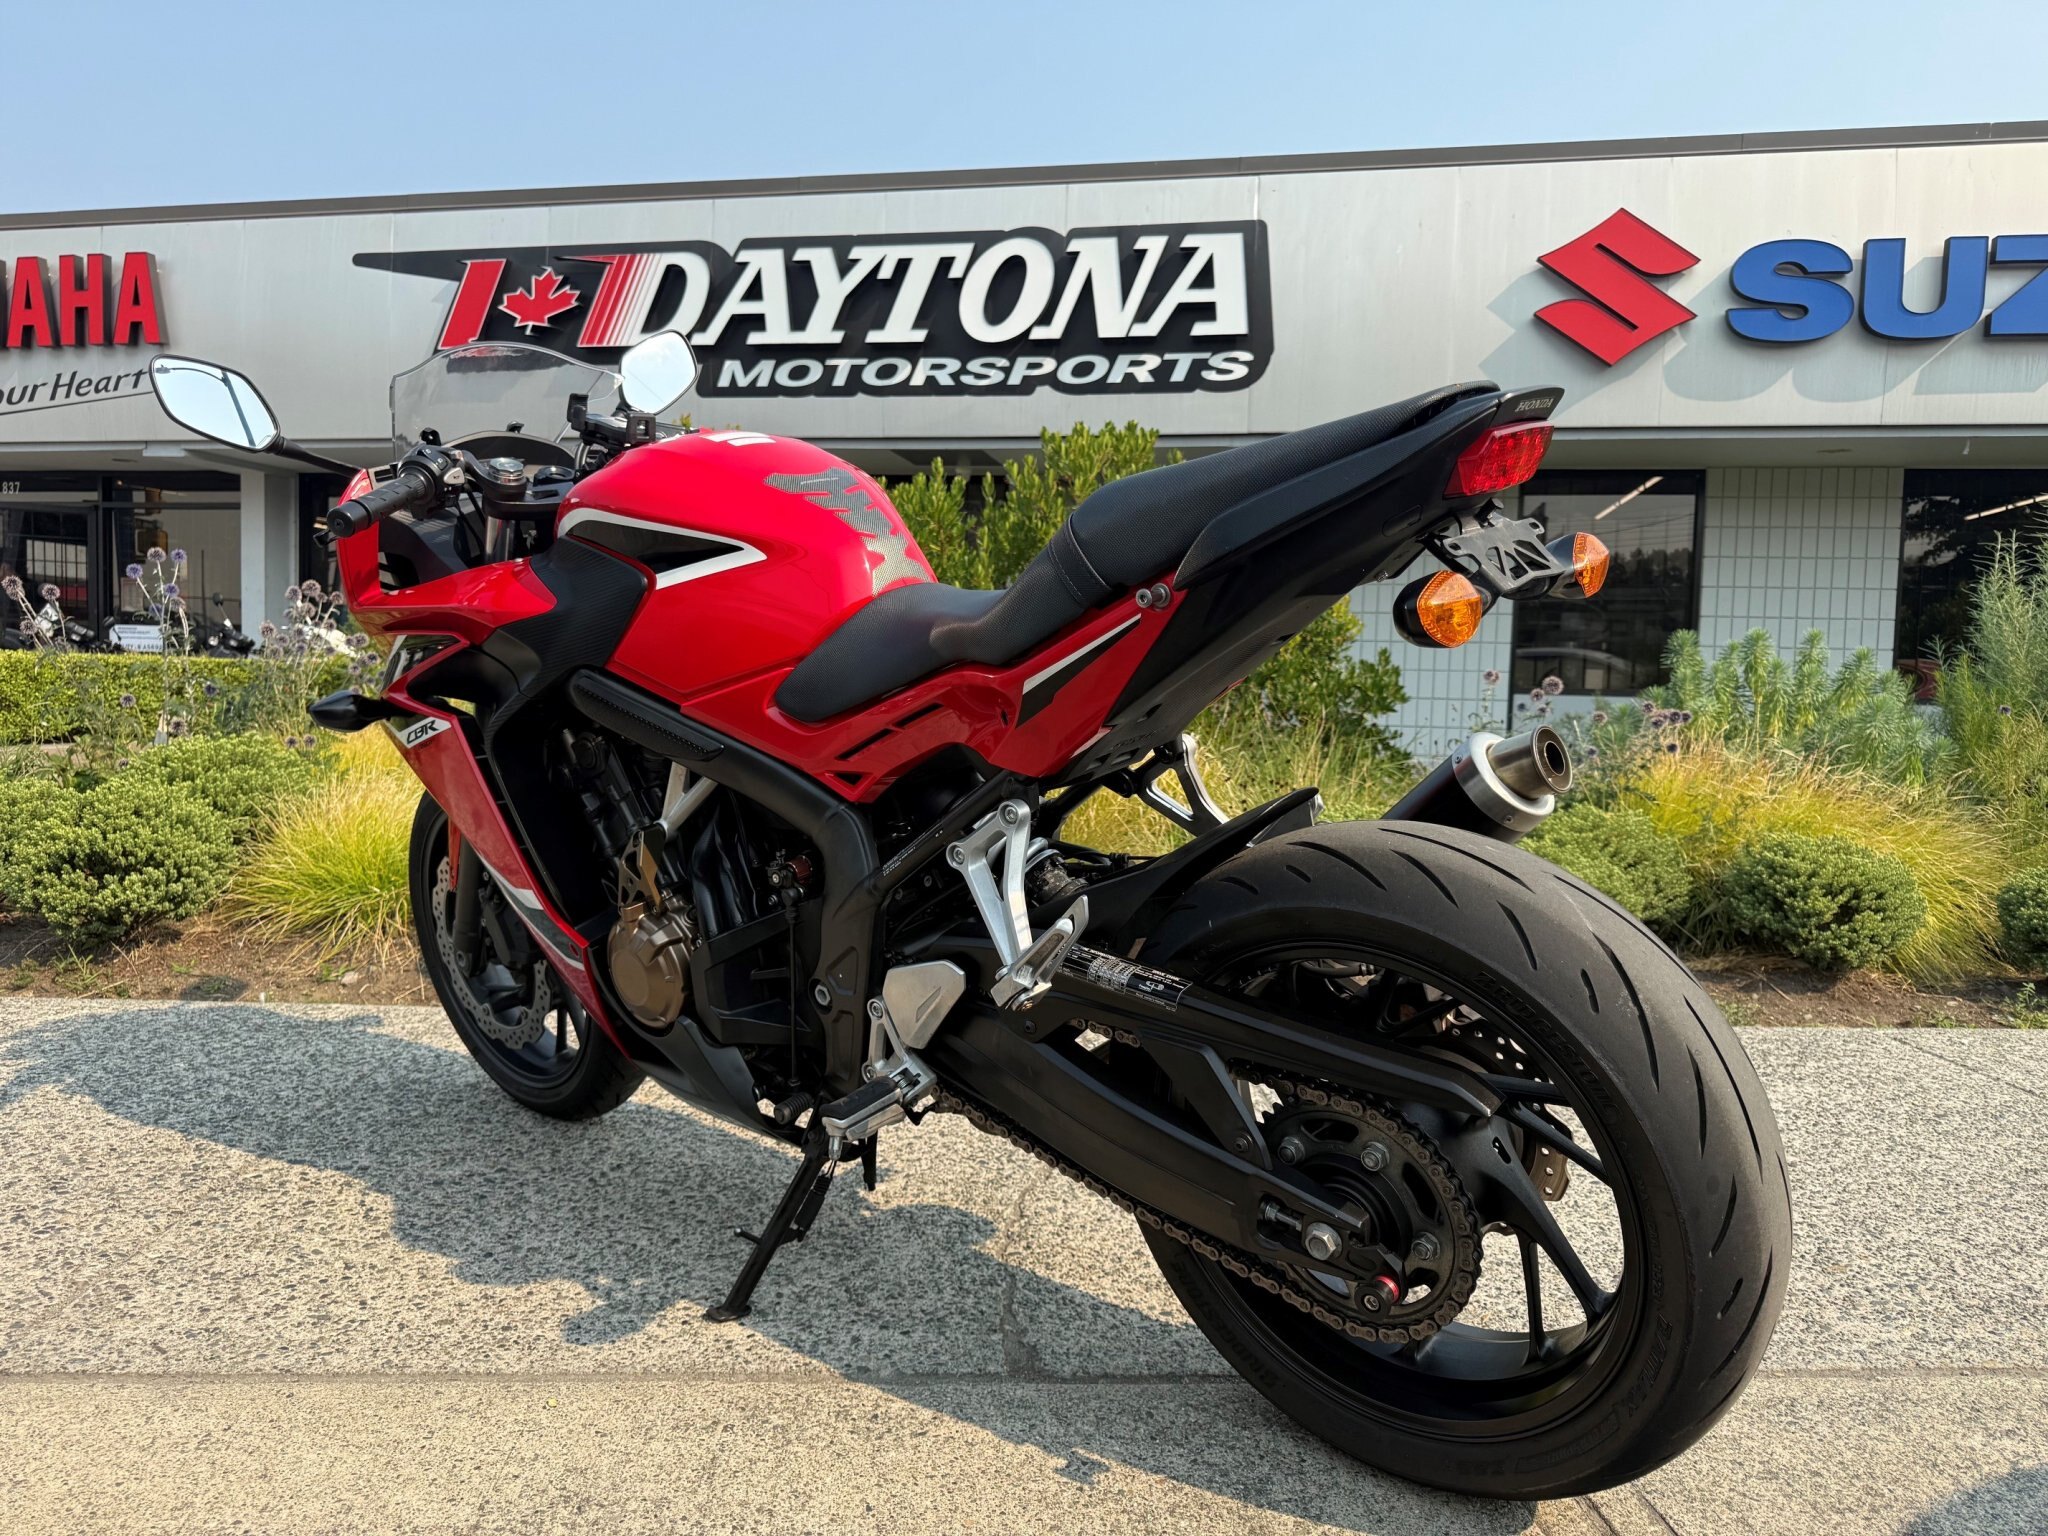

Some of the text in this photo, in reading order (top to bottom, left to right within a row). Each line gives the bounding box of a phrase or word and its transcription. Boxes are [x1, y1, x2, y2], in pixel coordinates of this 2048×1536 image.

[0, 252, 166, 348] AHA
[622, 231, 1250, 347] DAYTONA
[716, 350, 1255, 388] MOTORSPORTS
[0, 370, 149, 406] ur Heart
[1514, 398, 1554, 412] HONDA
[2, 481, 20, 495] 837
[406, 719, 440, 745] CBR
